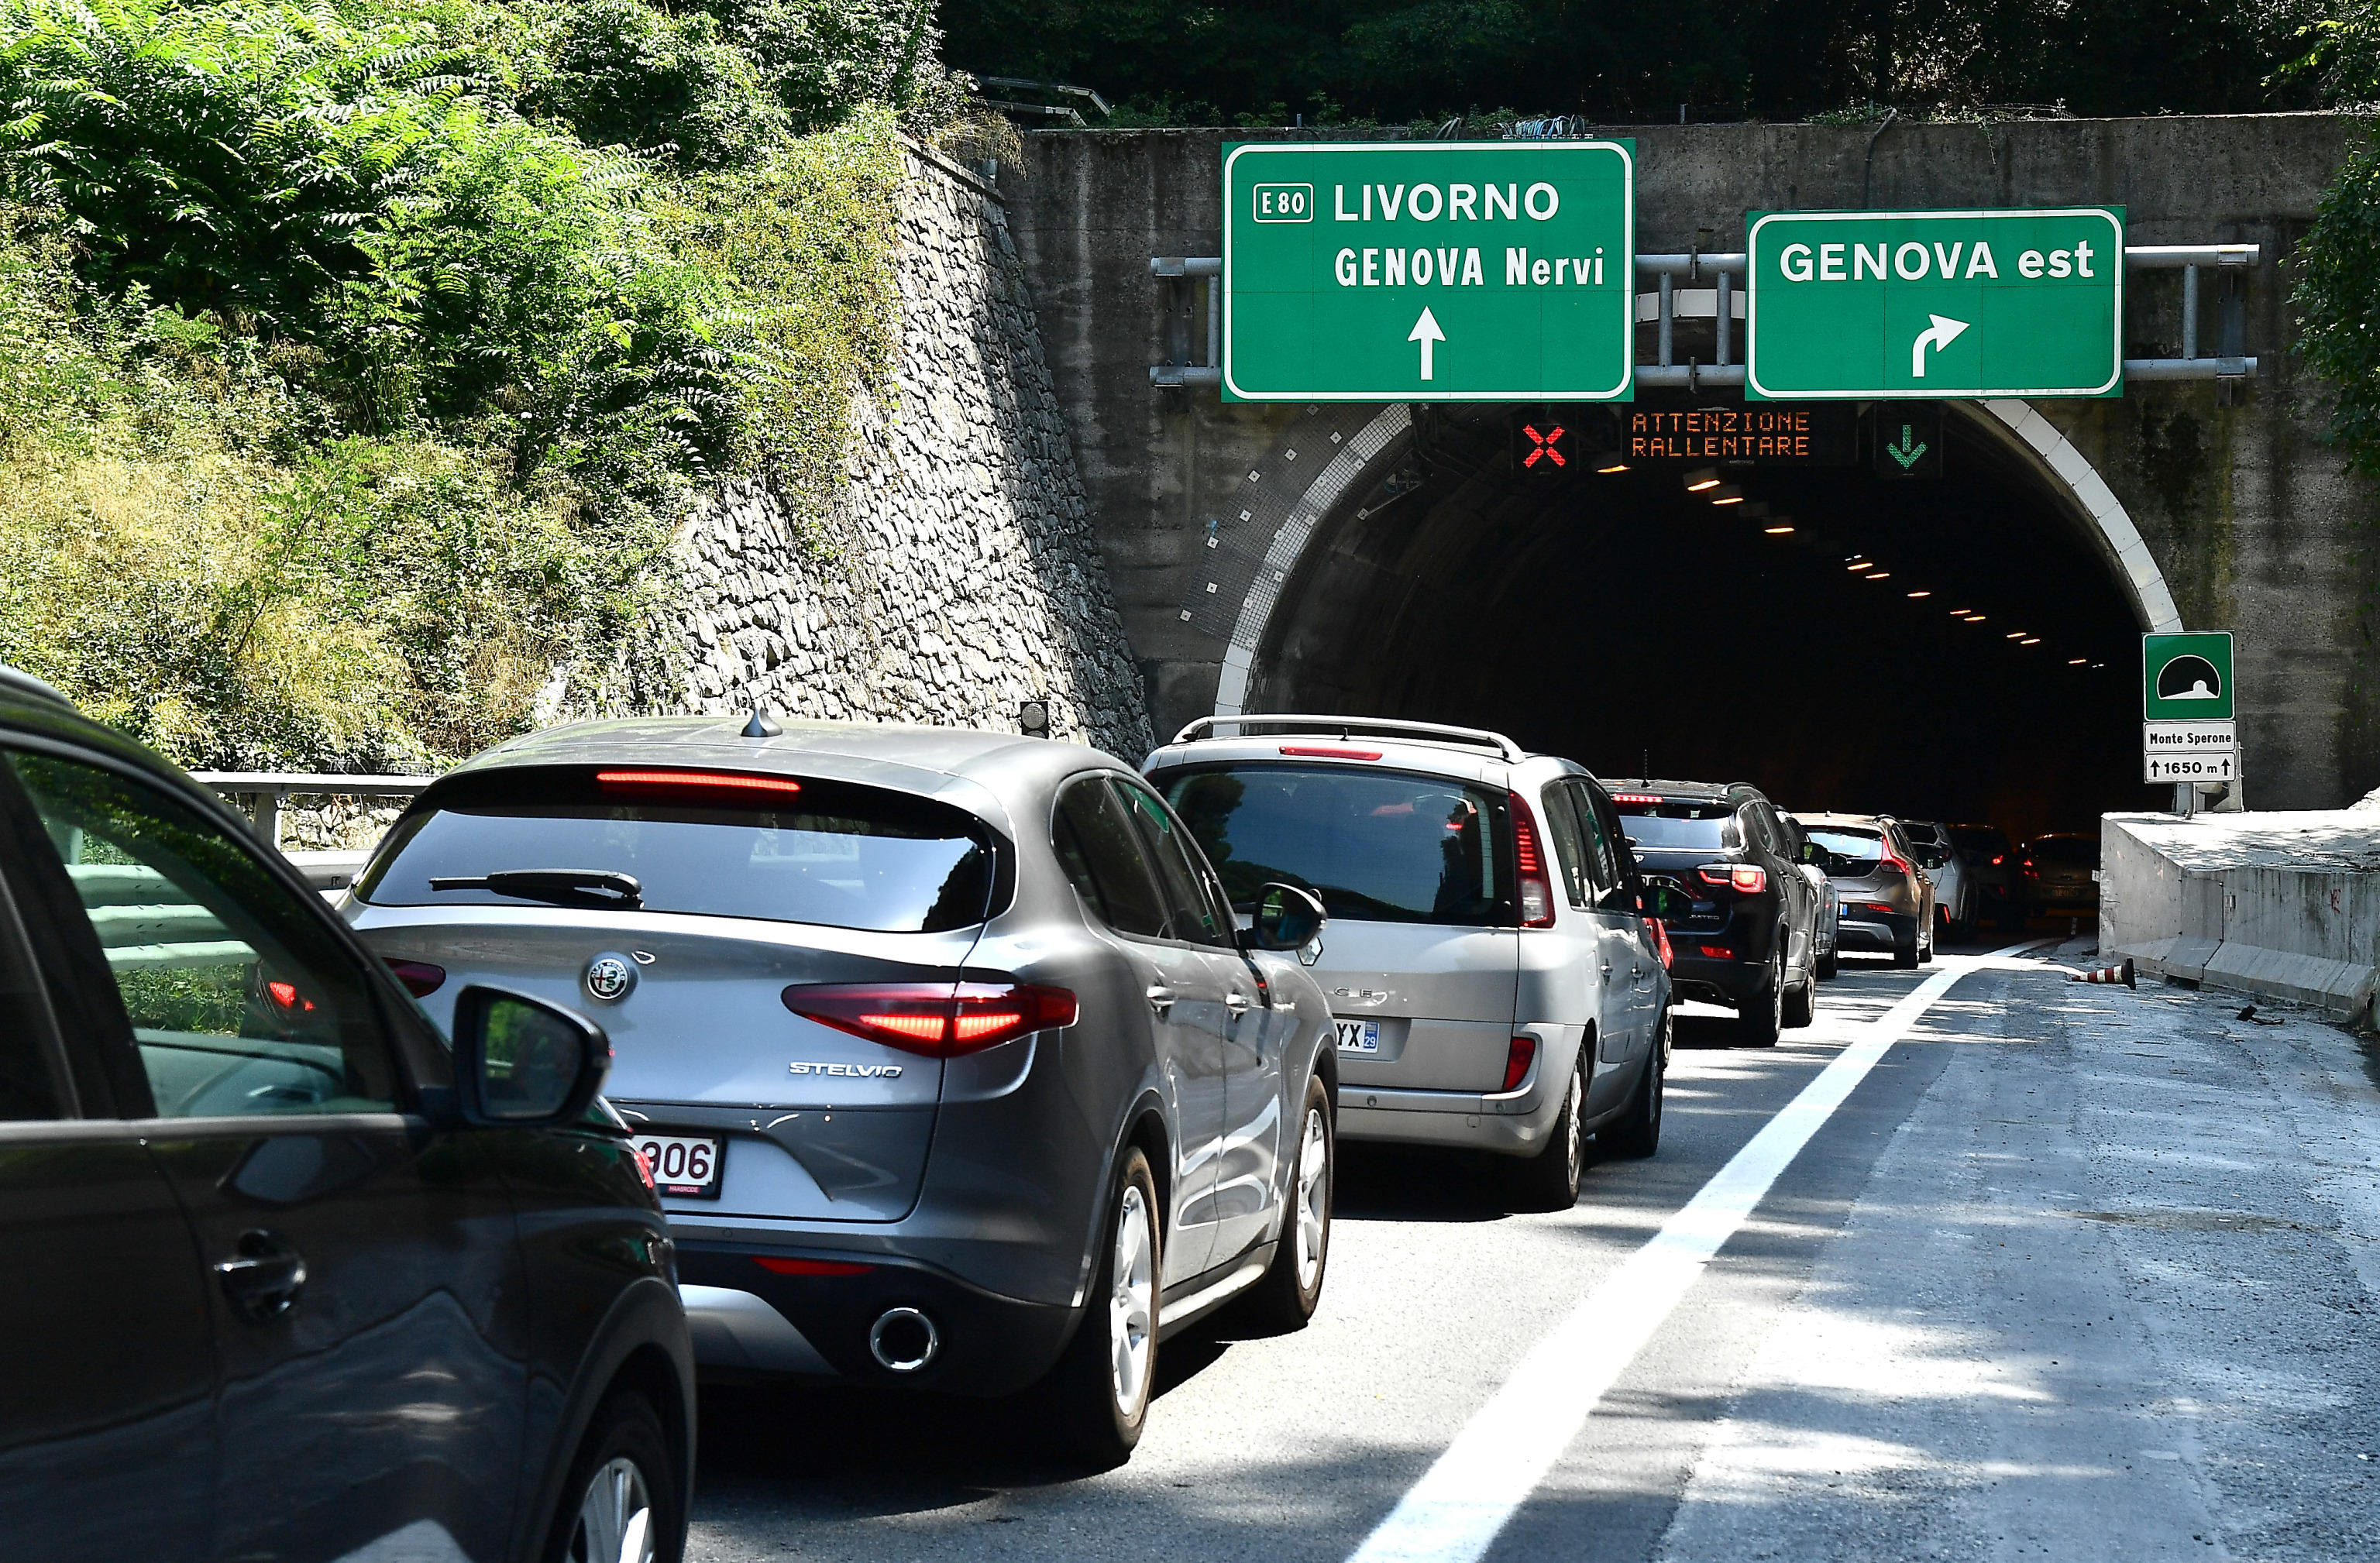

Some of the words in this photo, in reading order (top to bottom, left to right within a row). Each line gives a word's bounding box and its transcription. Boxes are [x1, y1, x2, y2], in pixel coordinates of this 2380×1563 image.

[1261, 192, 1271, 214] E
[1278, 191, 1305, 215] 80
[1334, 182, 1560, 222] LIVORNO
[1334, 247, 1484, 287] GENOVA
[1505, 247, 1604, 286] Nervi
[1780, 241, 1999, 282] GENOVA
[2017, 239, 2094, 279] est
[1632, 412, 1810, 432] ATTENZIONE
[1632, 436, 1810, 457] RALLENTARE
[2150, 733, 2183, 745] Monte
[2187, 732, 2232, 746] Sperone
[2164, 761, 2202, 775] 1650
[2207, 764, 2217, 774] m
[1364, 1036, 1377, 1048] 29
[789, 1061, 903, 1078] STELVIO
